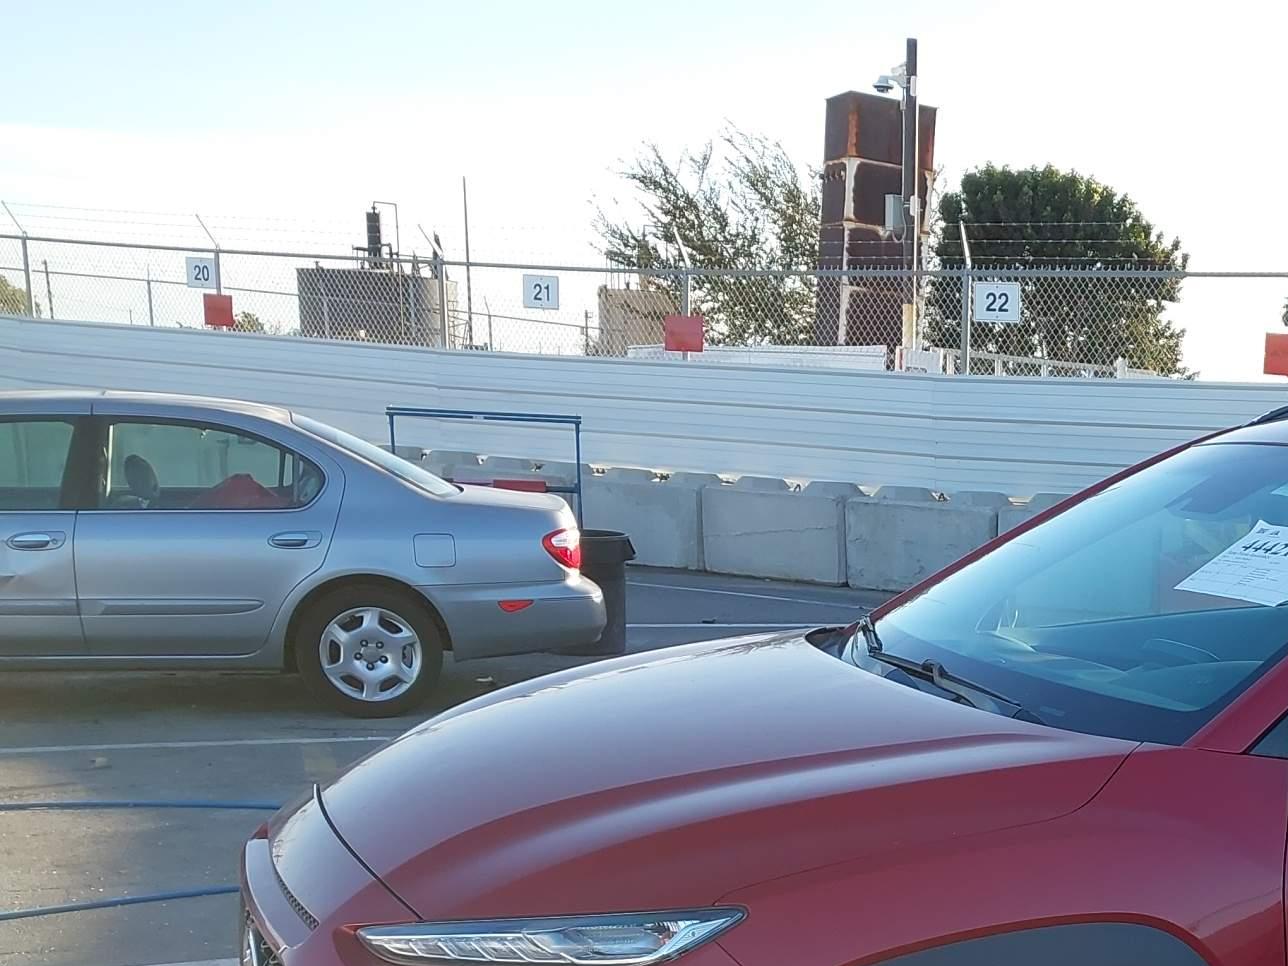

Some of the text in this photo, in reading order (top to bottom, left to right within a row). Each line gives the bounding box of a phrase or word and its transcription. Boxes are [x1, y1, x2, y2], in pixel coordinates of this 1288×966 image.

[193, 264, 210, 282] 20
[532, 283, 550, 302] 21
[985, 292, 1009, 313] 22
